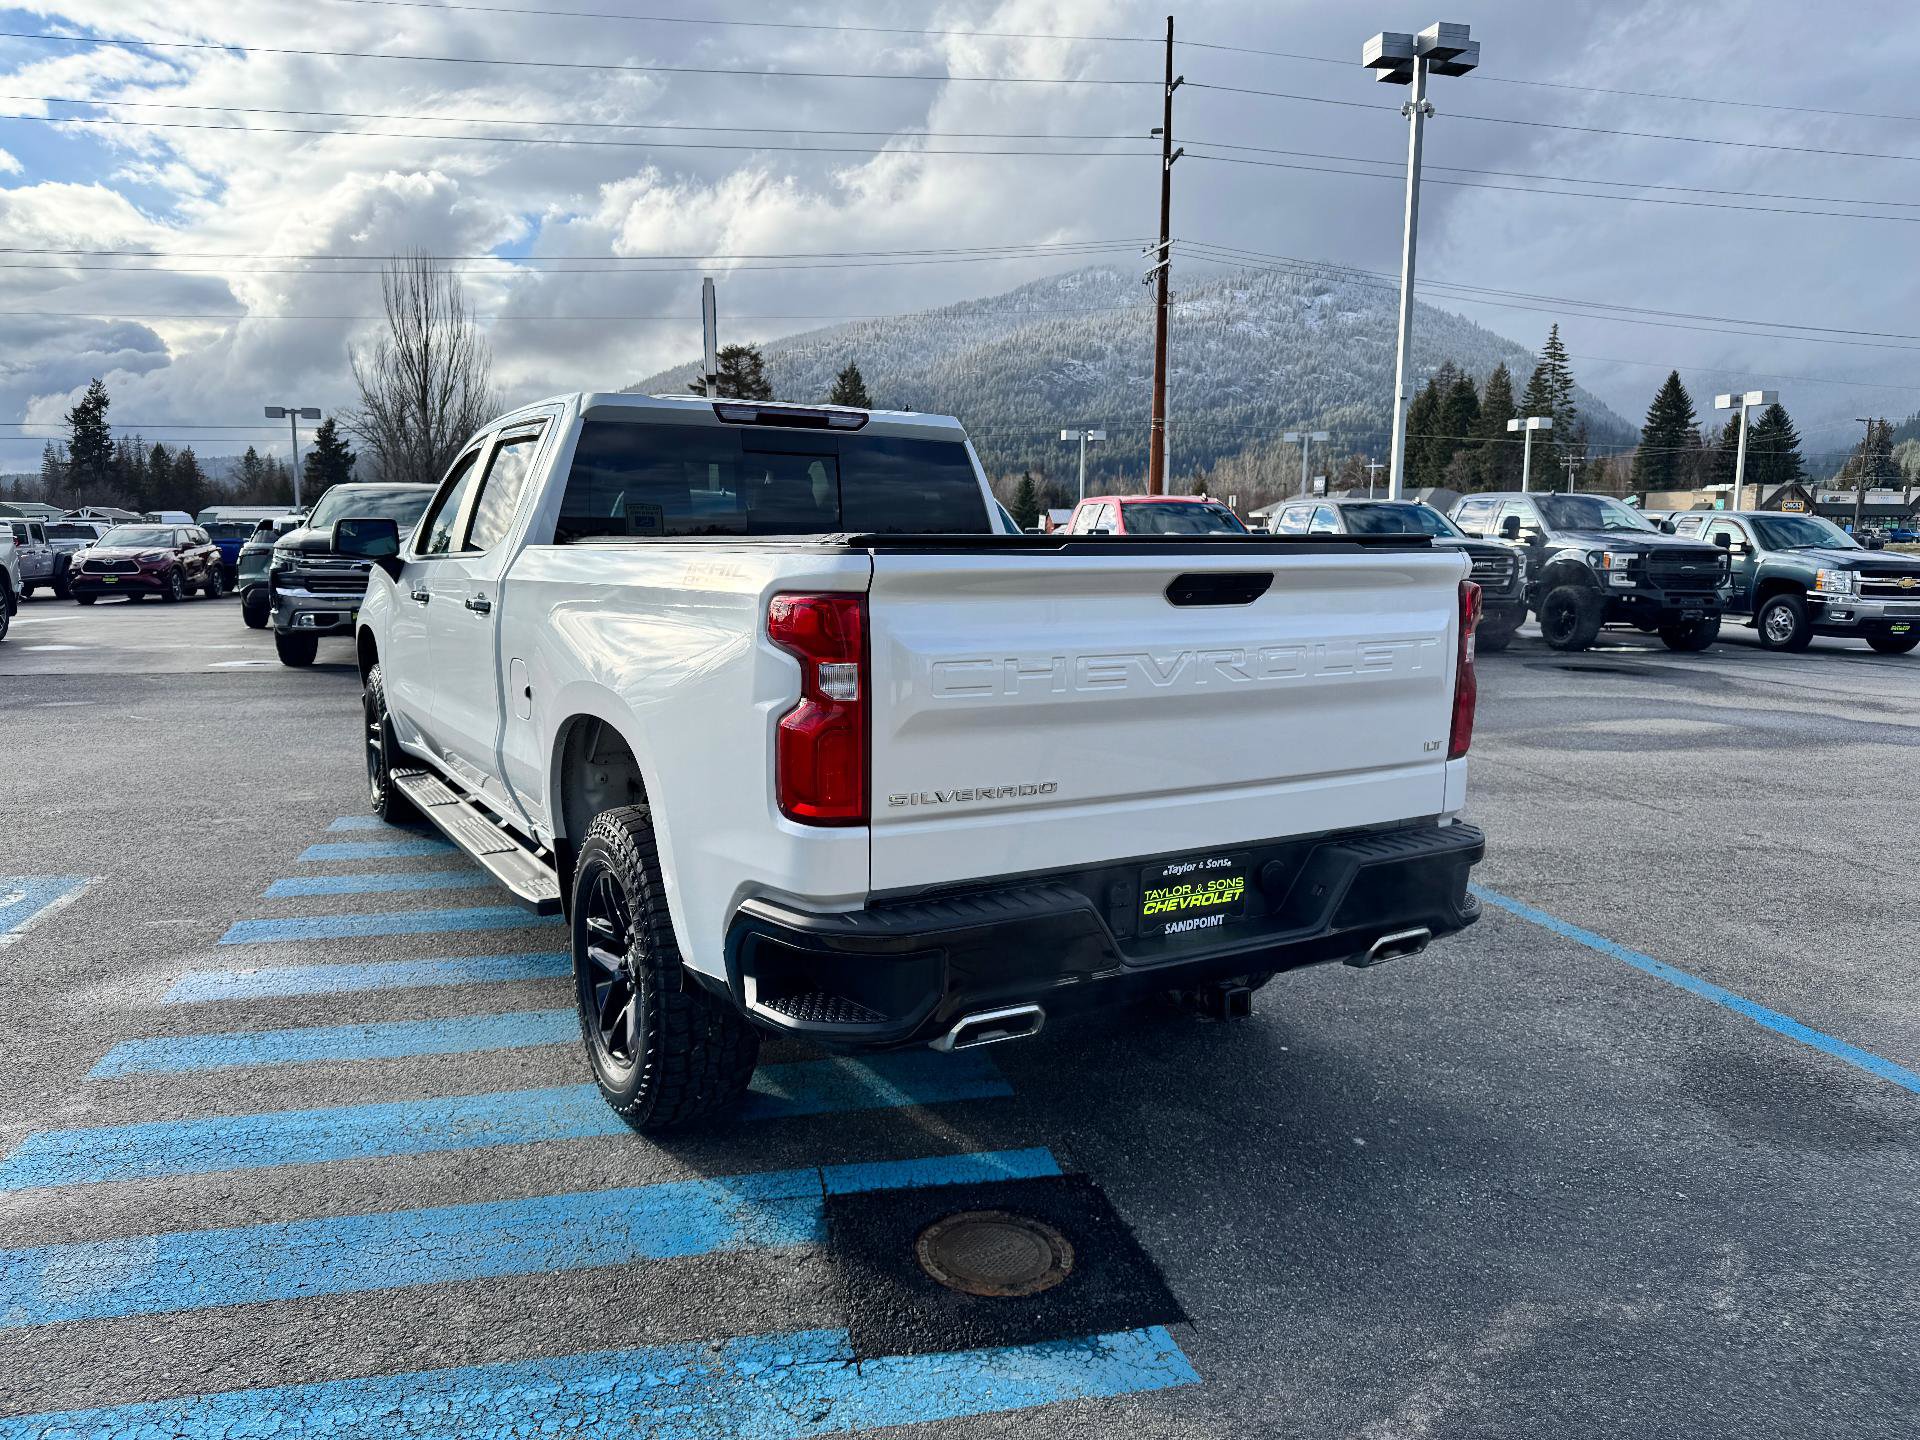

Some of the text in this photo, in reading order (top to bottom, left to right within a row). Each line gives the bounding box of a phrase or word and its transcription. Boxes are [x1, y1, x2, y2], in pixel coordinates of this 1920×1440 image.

[931, 637, 1441, 699] CHEVROLET
[1424, 740, 1443, 752] LT
[888, 782, 1058, 807] SILVERADO
[1167, 862, 1196, 875] Taylor
[1206, 858, 1228, 869] Sons
[1144, 876, 1244, 901] TAYLOR & SONS
[1143, 888, 1244, 915] CHEVROLET
[1164, 914, 1225, 934] SANDPOINT
